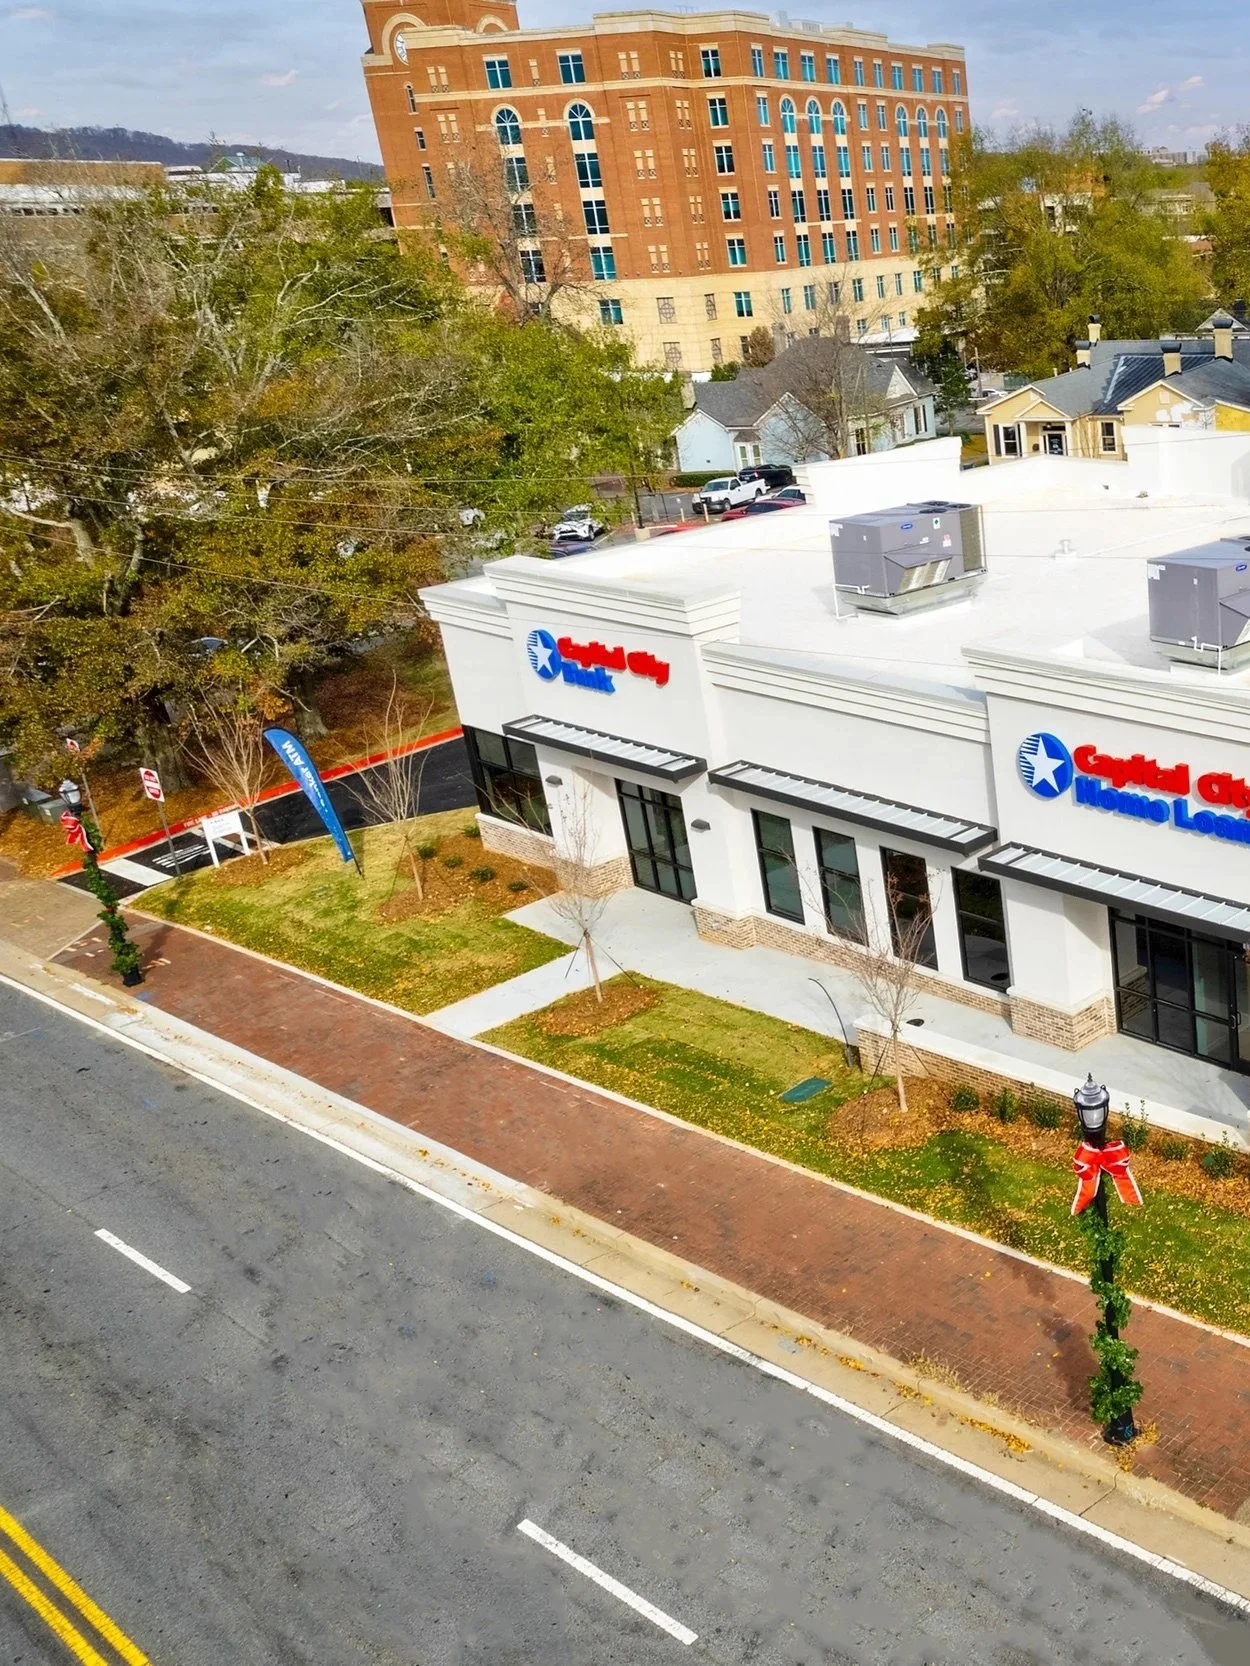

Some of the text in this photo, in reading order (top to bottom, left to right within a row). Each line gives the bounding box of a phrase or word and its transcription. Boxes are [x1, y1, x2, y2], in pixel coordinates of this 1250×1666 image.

[282, 740, 305, 767] ATM
[1074, 744, 1190, 796] Capital
[1074, 775, 1170, 823] Home
